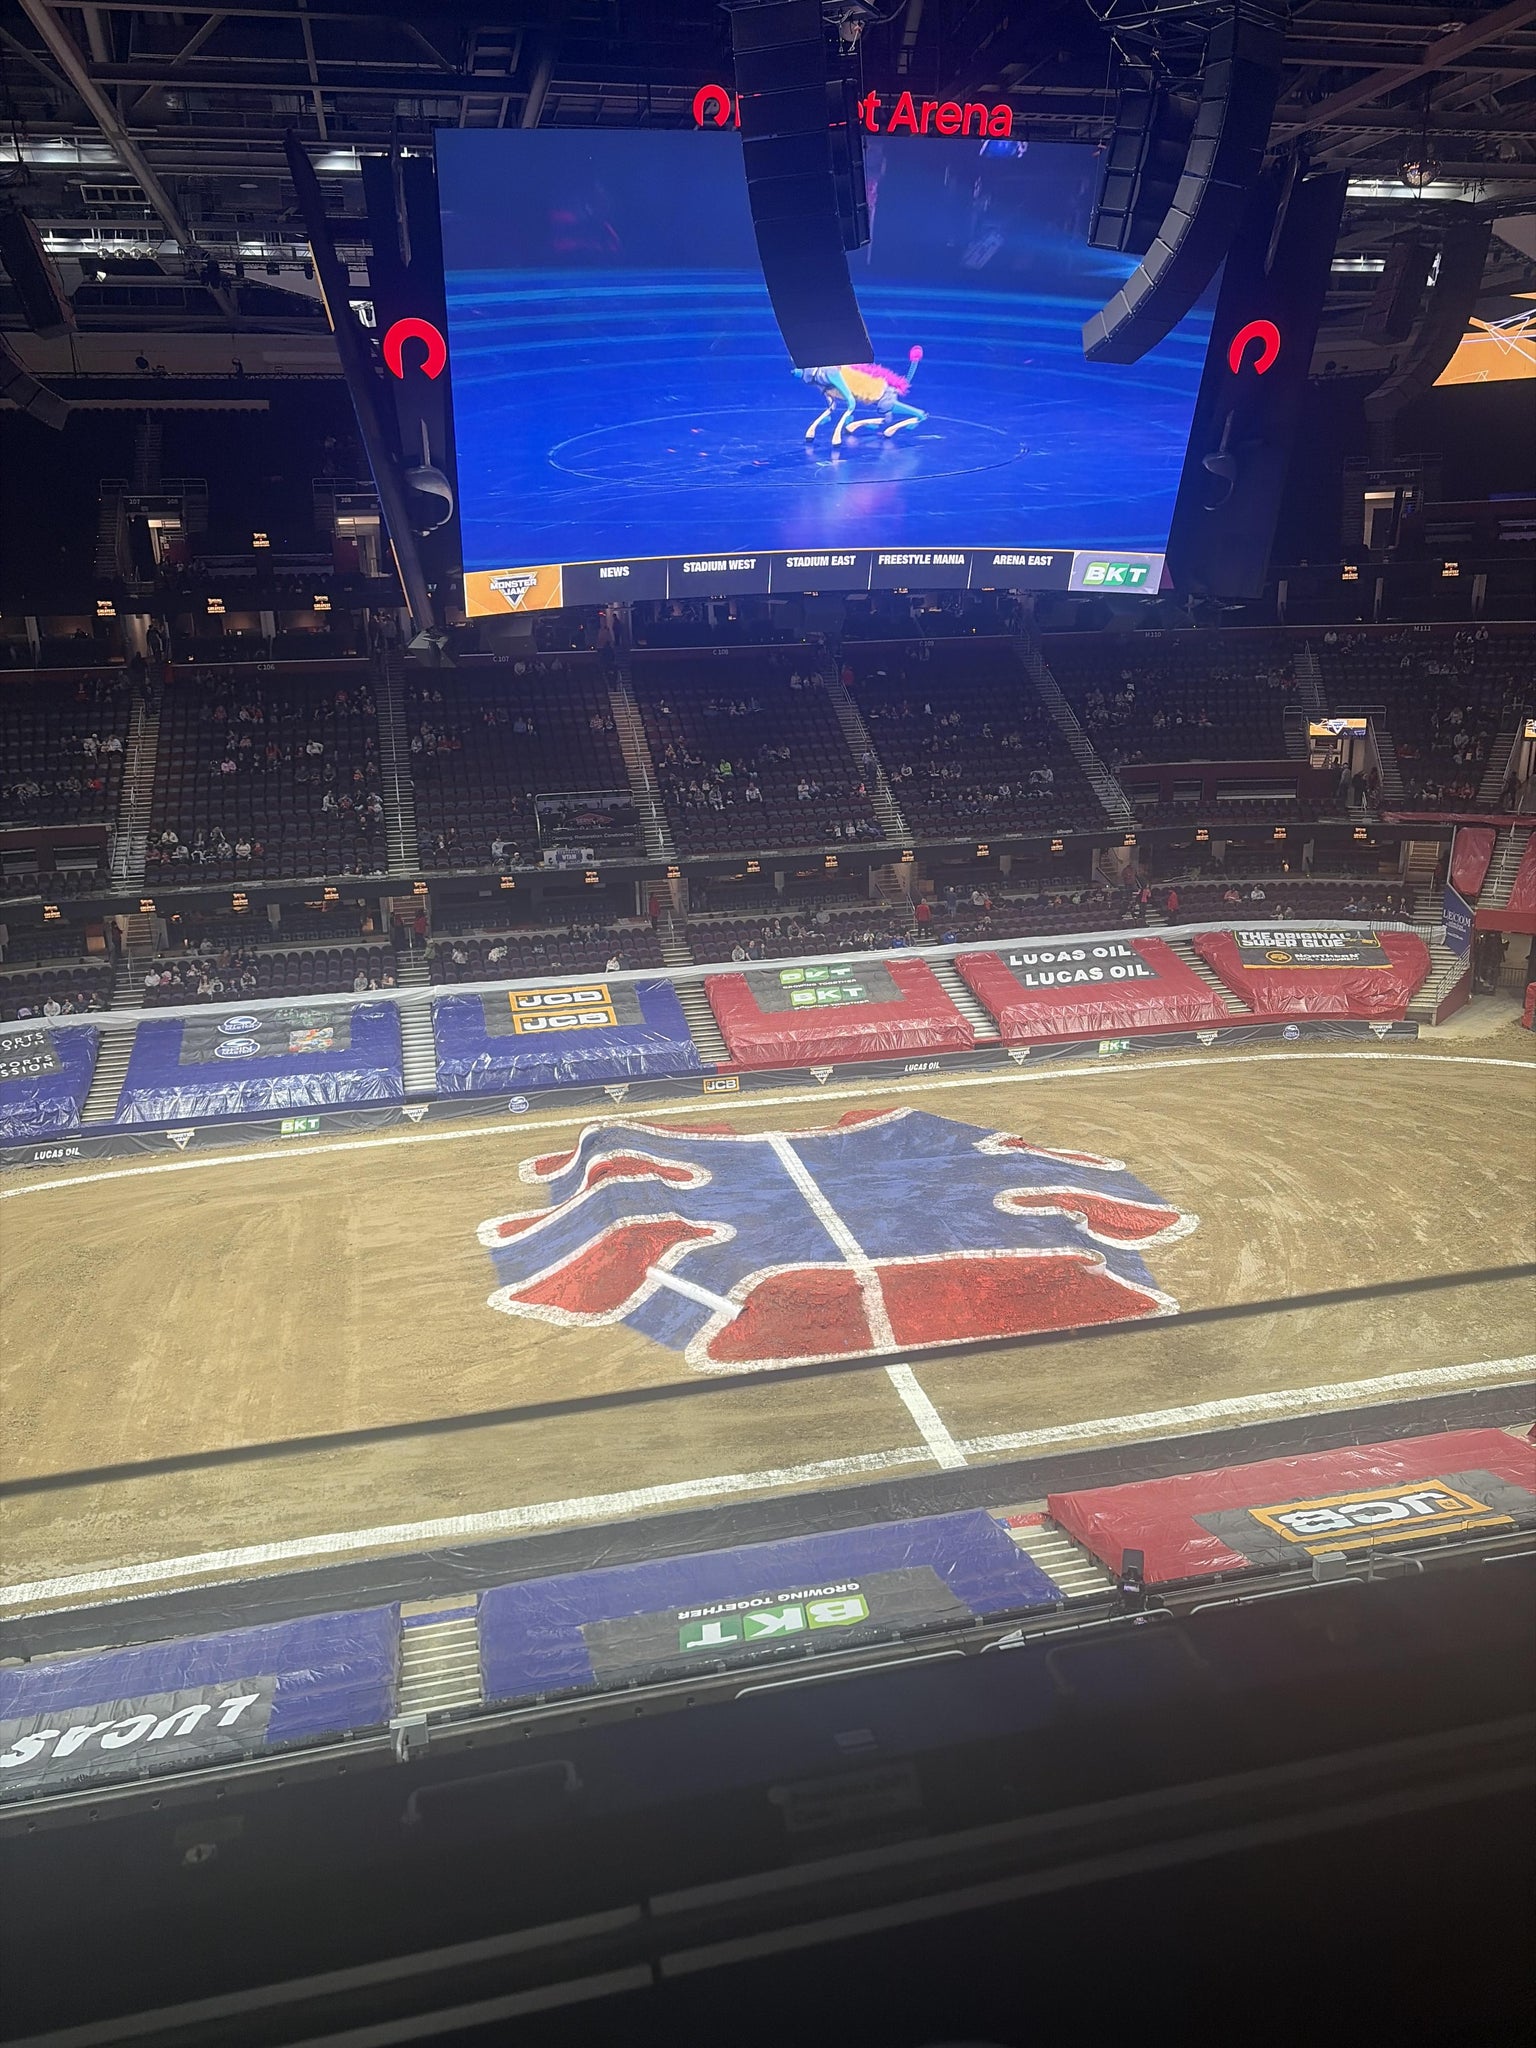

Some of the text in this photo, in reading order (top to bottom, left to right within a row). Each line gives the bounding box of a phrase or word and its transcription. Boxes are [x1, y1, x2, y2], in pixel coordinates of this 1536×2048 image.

[887, 90, 1013, 137] Arena
[683, 558, 757, 573] STADIUM WEST
[786, 555, 856, 568] STADIUM EAST
[878, 554, 965, 566] FREESTYLE MANIA
[993, 555, 1053, 567] ARENA EAST
[599, 566, 630, 579] NEWS
[1086, 566, 1147, 584] BKT
[490, 577, 537, 590] MONSTER
[502, 587, 526, 596] JAM
[1443, 909, 1471, 927] LECOM
[1238, 931, 1271, 940] THE
[1242, 939, 1346, 948] SUPER GLUE
[1009, 949, 1086, 967] LUCAS
[1025, 966, 1104, 986] LUCAS
[794, 987, 863, 1002] BKT
[523, 1012, 608, 1030] JCB
[1099, 1040, 1130, 1052] BKT
[904, 1061, 941, 1072] LUCAS OIL
[706, 1080, 737, 1091] JCB
[281, 1118, 319, 1132] BKT
[34, 1147, 80, 1161] LUCAS OIL
[1278, 1492, 1448, 1533] JCB
[677, 1582, 860, 1620] GROWING TOGETHER
[686, 1598, 867, 1649] BKT
[0, 1692, 262, 1768] LUCAS
